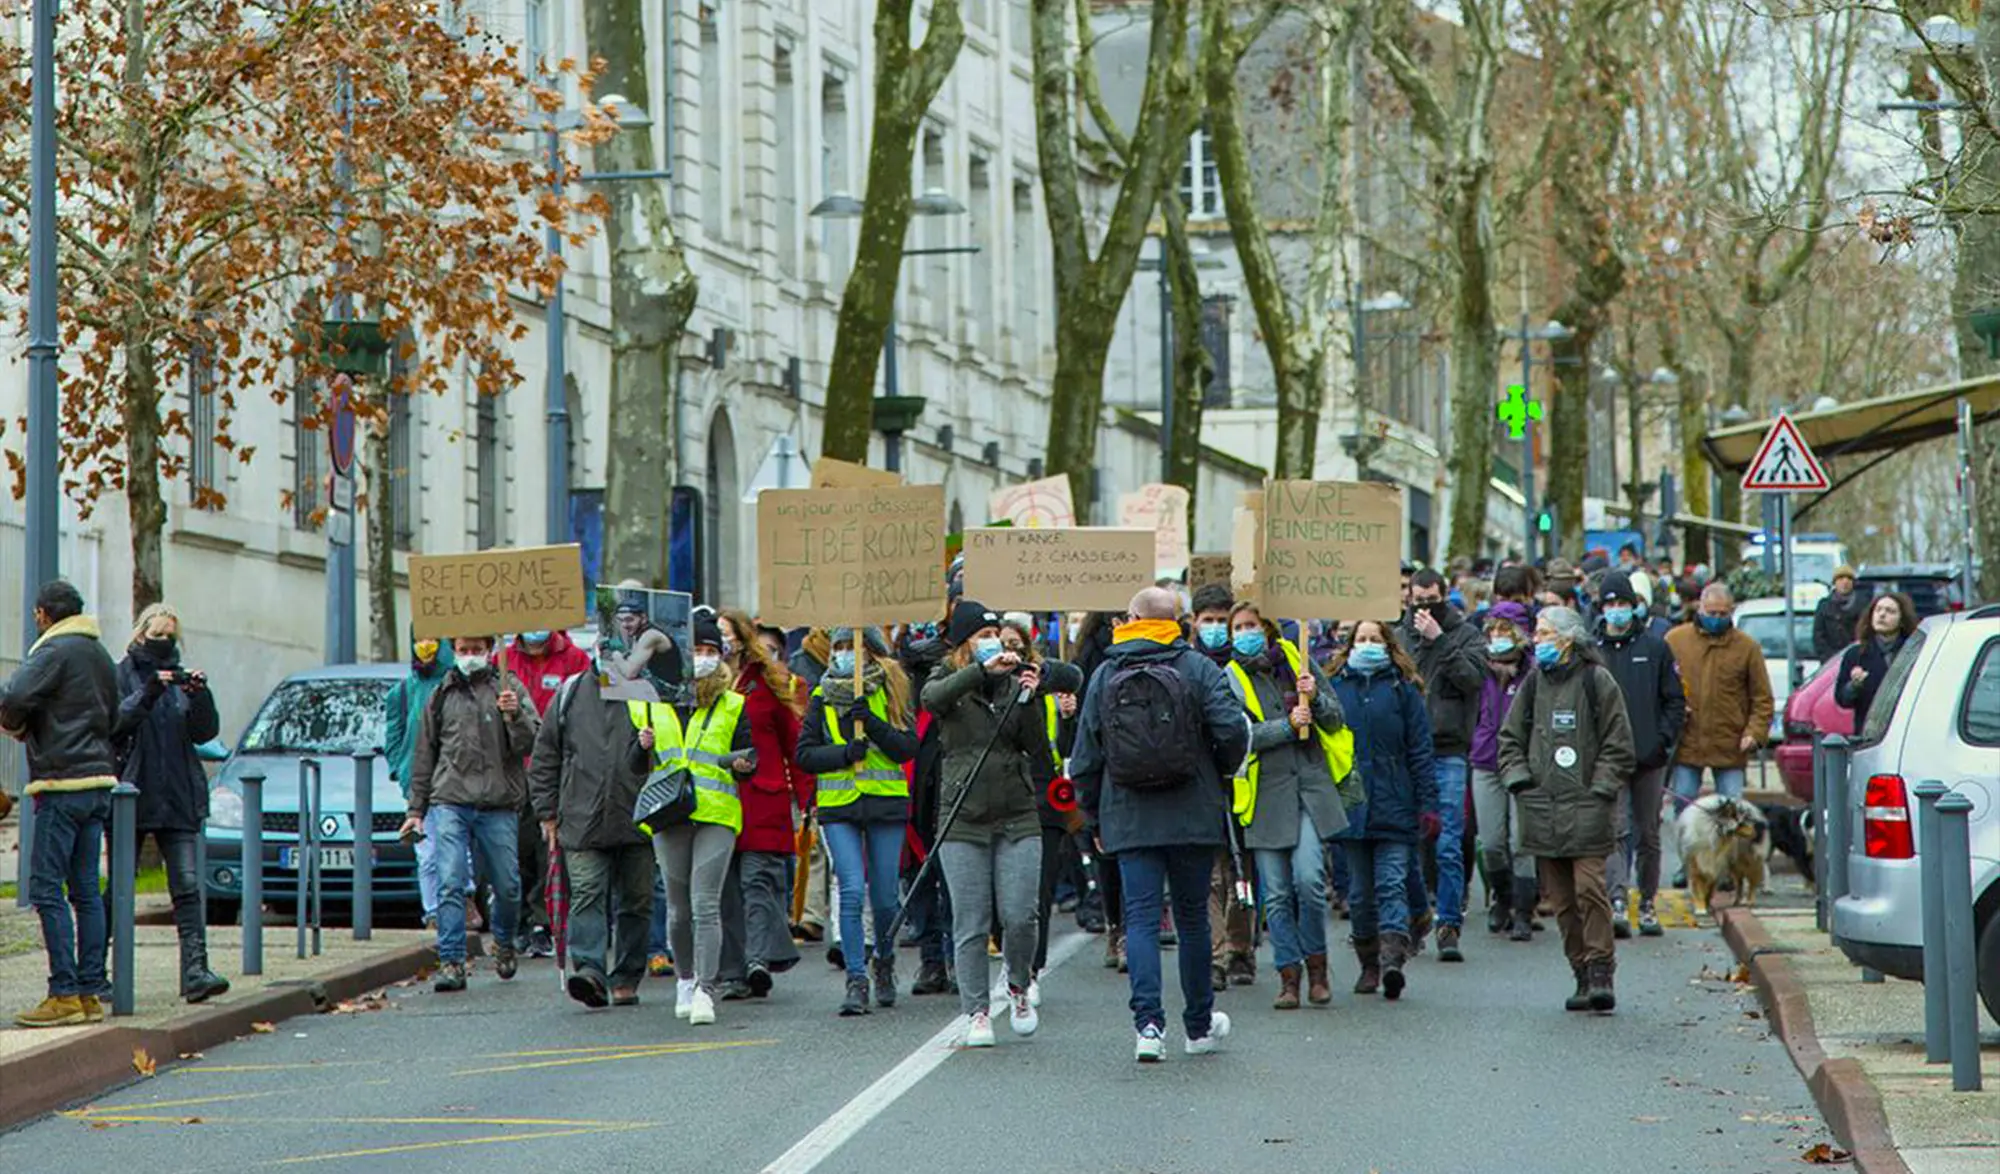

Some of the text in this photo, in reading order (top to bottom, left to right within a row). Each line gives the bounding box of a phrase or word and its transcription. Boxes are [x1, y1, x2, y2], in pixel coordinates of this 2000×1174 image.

[777, 503, 799, 516] un
[803, 498, 832, 518] jour
[843, 501, 863, 515] un
[772, 517, 938, 566] LIBÉRONS
[972, 533, 995, 547] EN
[1266, 518, 1389, 543] EINEMENT
[1306, 549, 1346, 569] NOS
[420, 557, 559, 591] REFORME
[772, 564, 945, 610] LA PAROLE
[422, 587, 575, 617] DE LA CHASSE
